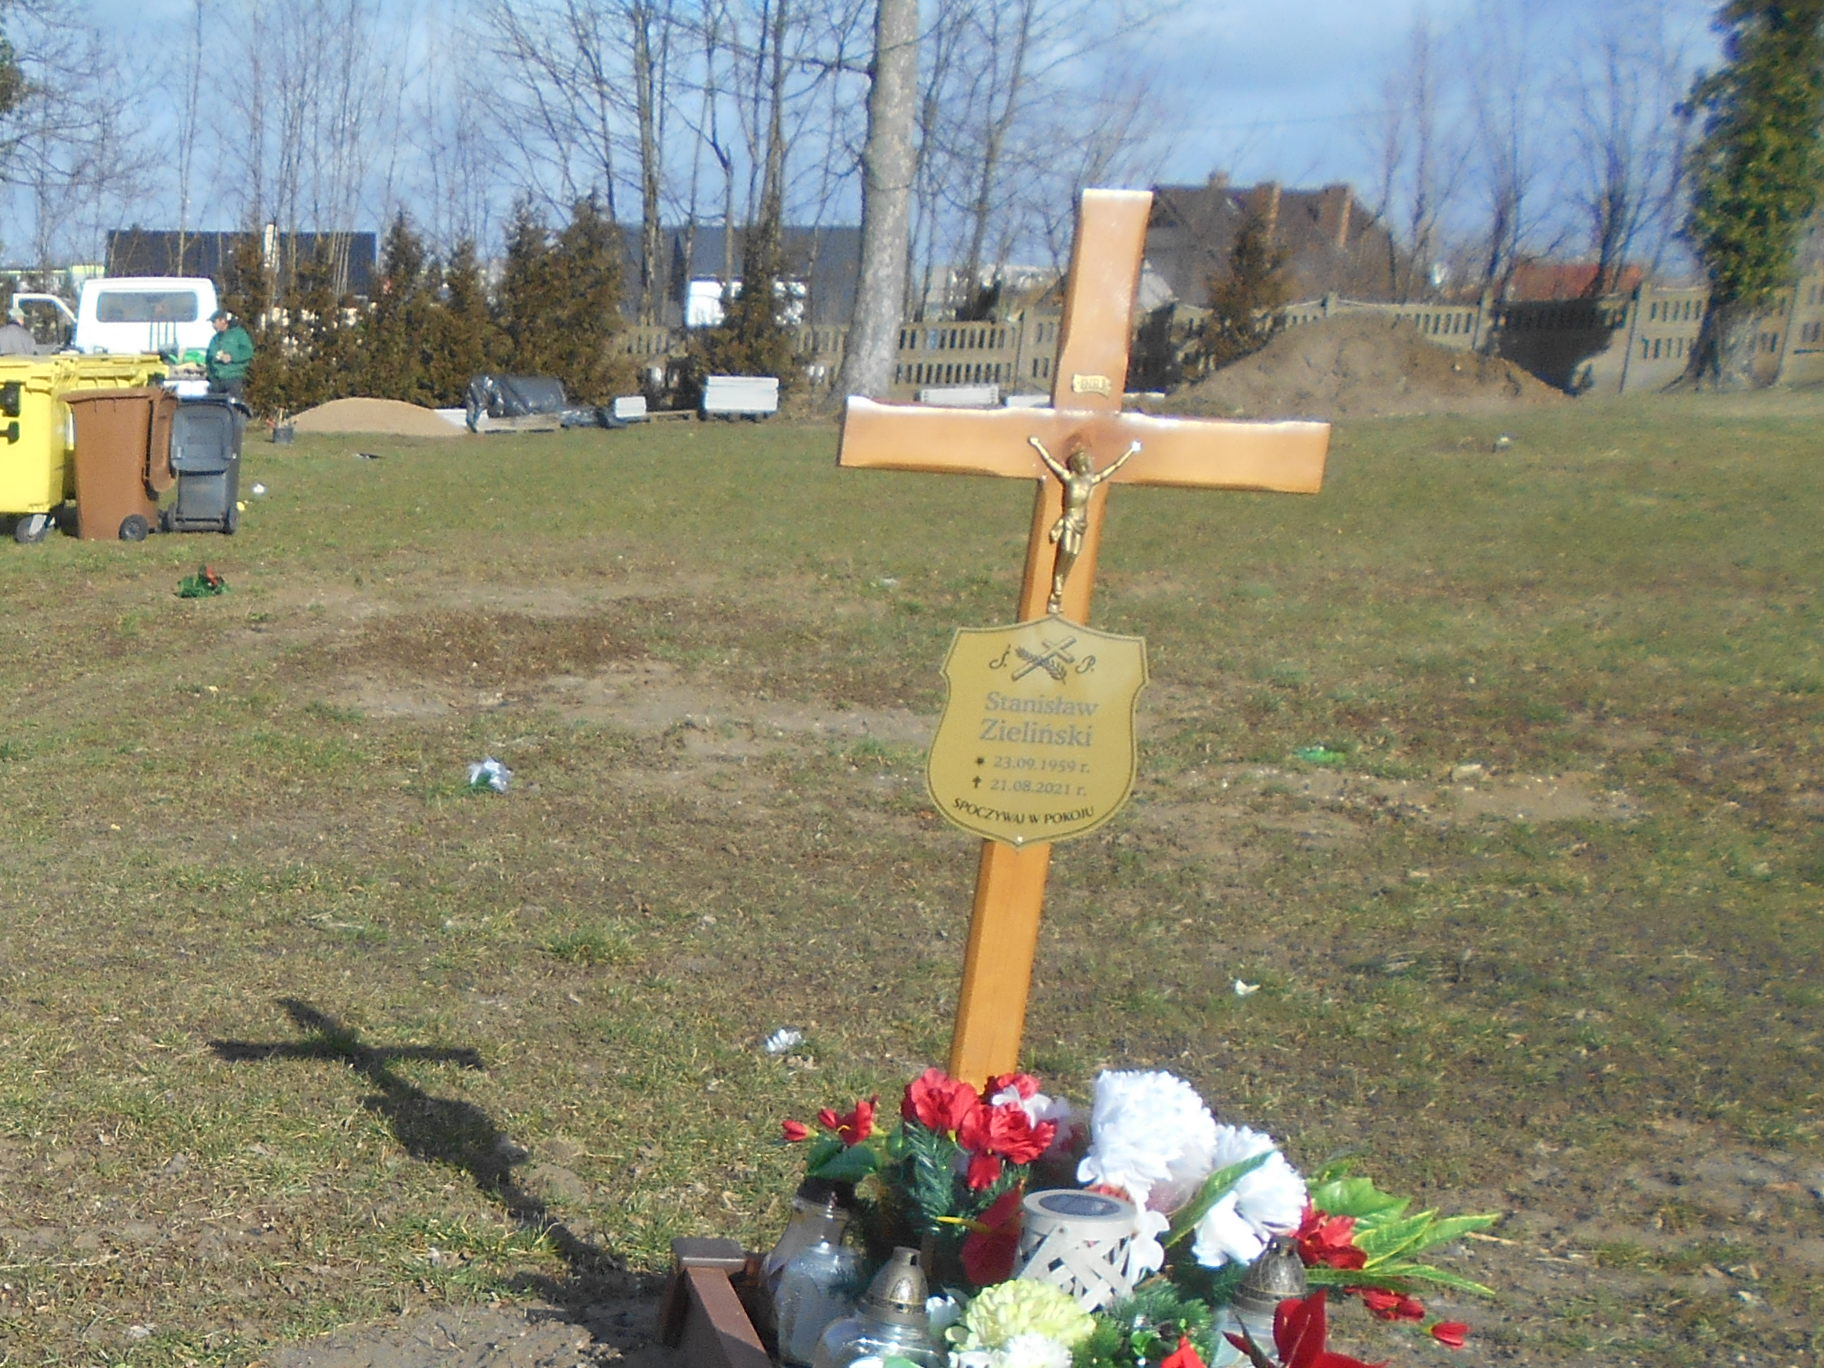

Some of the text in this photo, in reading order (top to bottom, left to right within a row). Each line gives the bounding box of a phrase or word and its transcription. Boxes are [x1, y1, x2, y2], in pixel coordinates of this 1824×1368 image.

[984, 690, 1100, 716] Stanisław
[978, 717, 1094, 748] Zieliński
[993, 755, 1091, 774] 23.09.1959 r.
[990, 778, 1088, 797] 21.08.2021 r.
[952, 797, 1095, 825] SPOCZYWAJ W POKOJU
